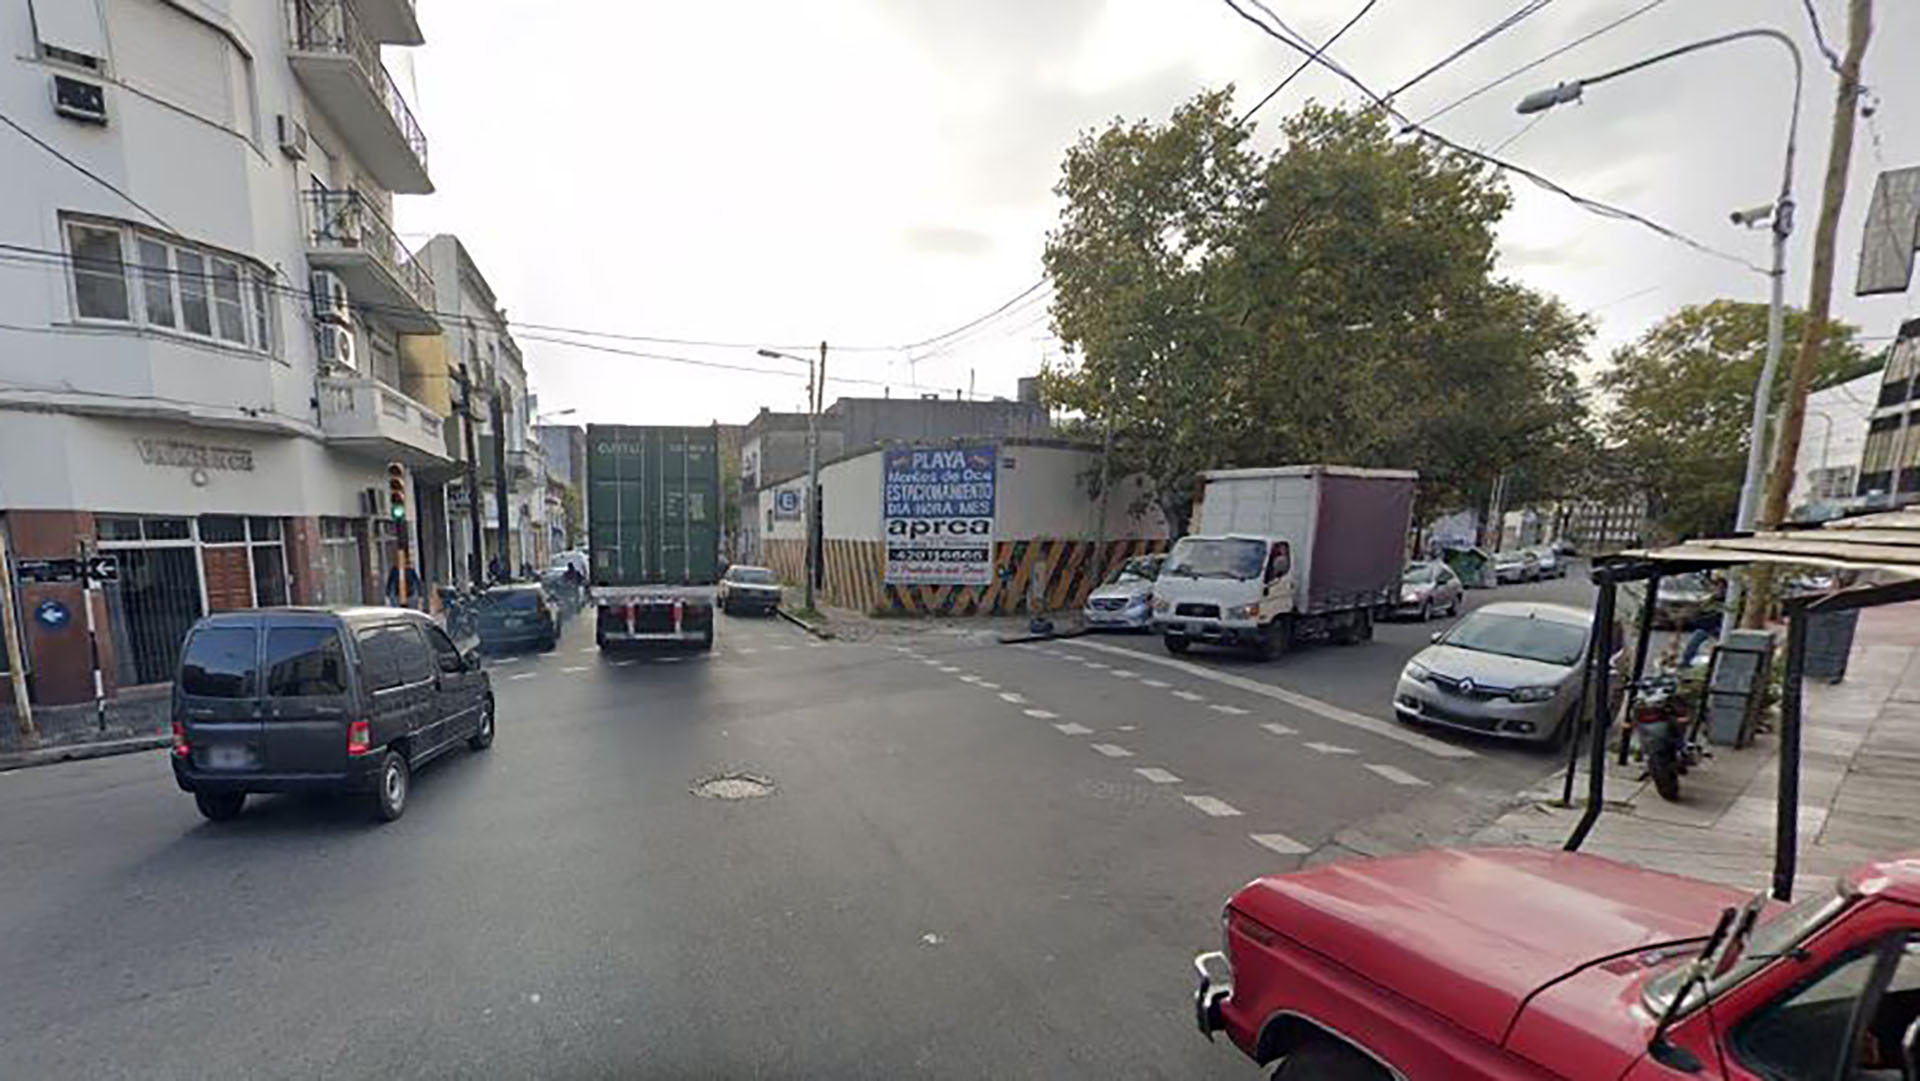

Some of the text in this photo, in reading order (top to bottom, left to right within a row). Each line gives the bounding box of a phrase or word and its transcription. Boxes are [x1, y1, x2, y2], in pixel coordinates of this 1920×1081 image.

[913, 451, 966, 469] PLAYA
[888, 470, 937, 482] Montes
[886, 483, 993, 501] ESTACIONAMIENTO
[915, 502, 954, 515] HORA
[959, 501, 990, 514] MES
